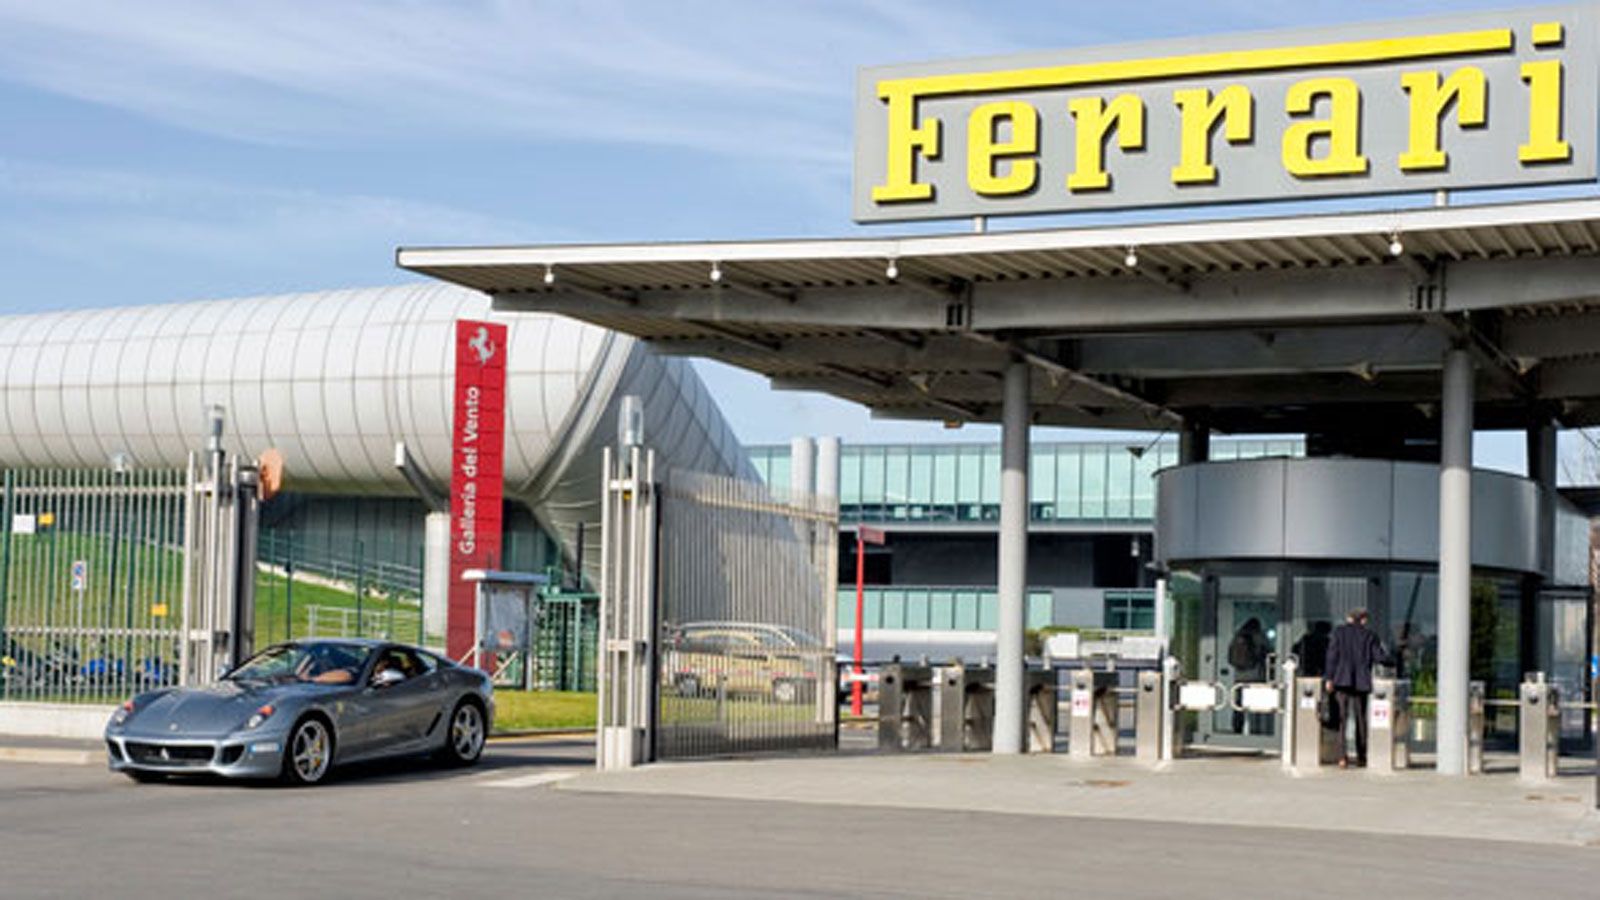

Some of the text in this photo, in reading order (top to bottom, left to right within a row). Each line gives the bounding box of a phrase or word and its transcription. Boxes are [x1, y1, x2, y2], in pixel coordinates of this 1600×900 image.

[872, 22, 1571, 203] Ferrari
[459, 386, 480, 555] Galleria del Vento
